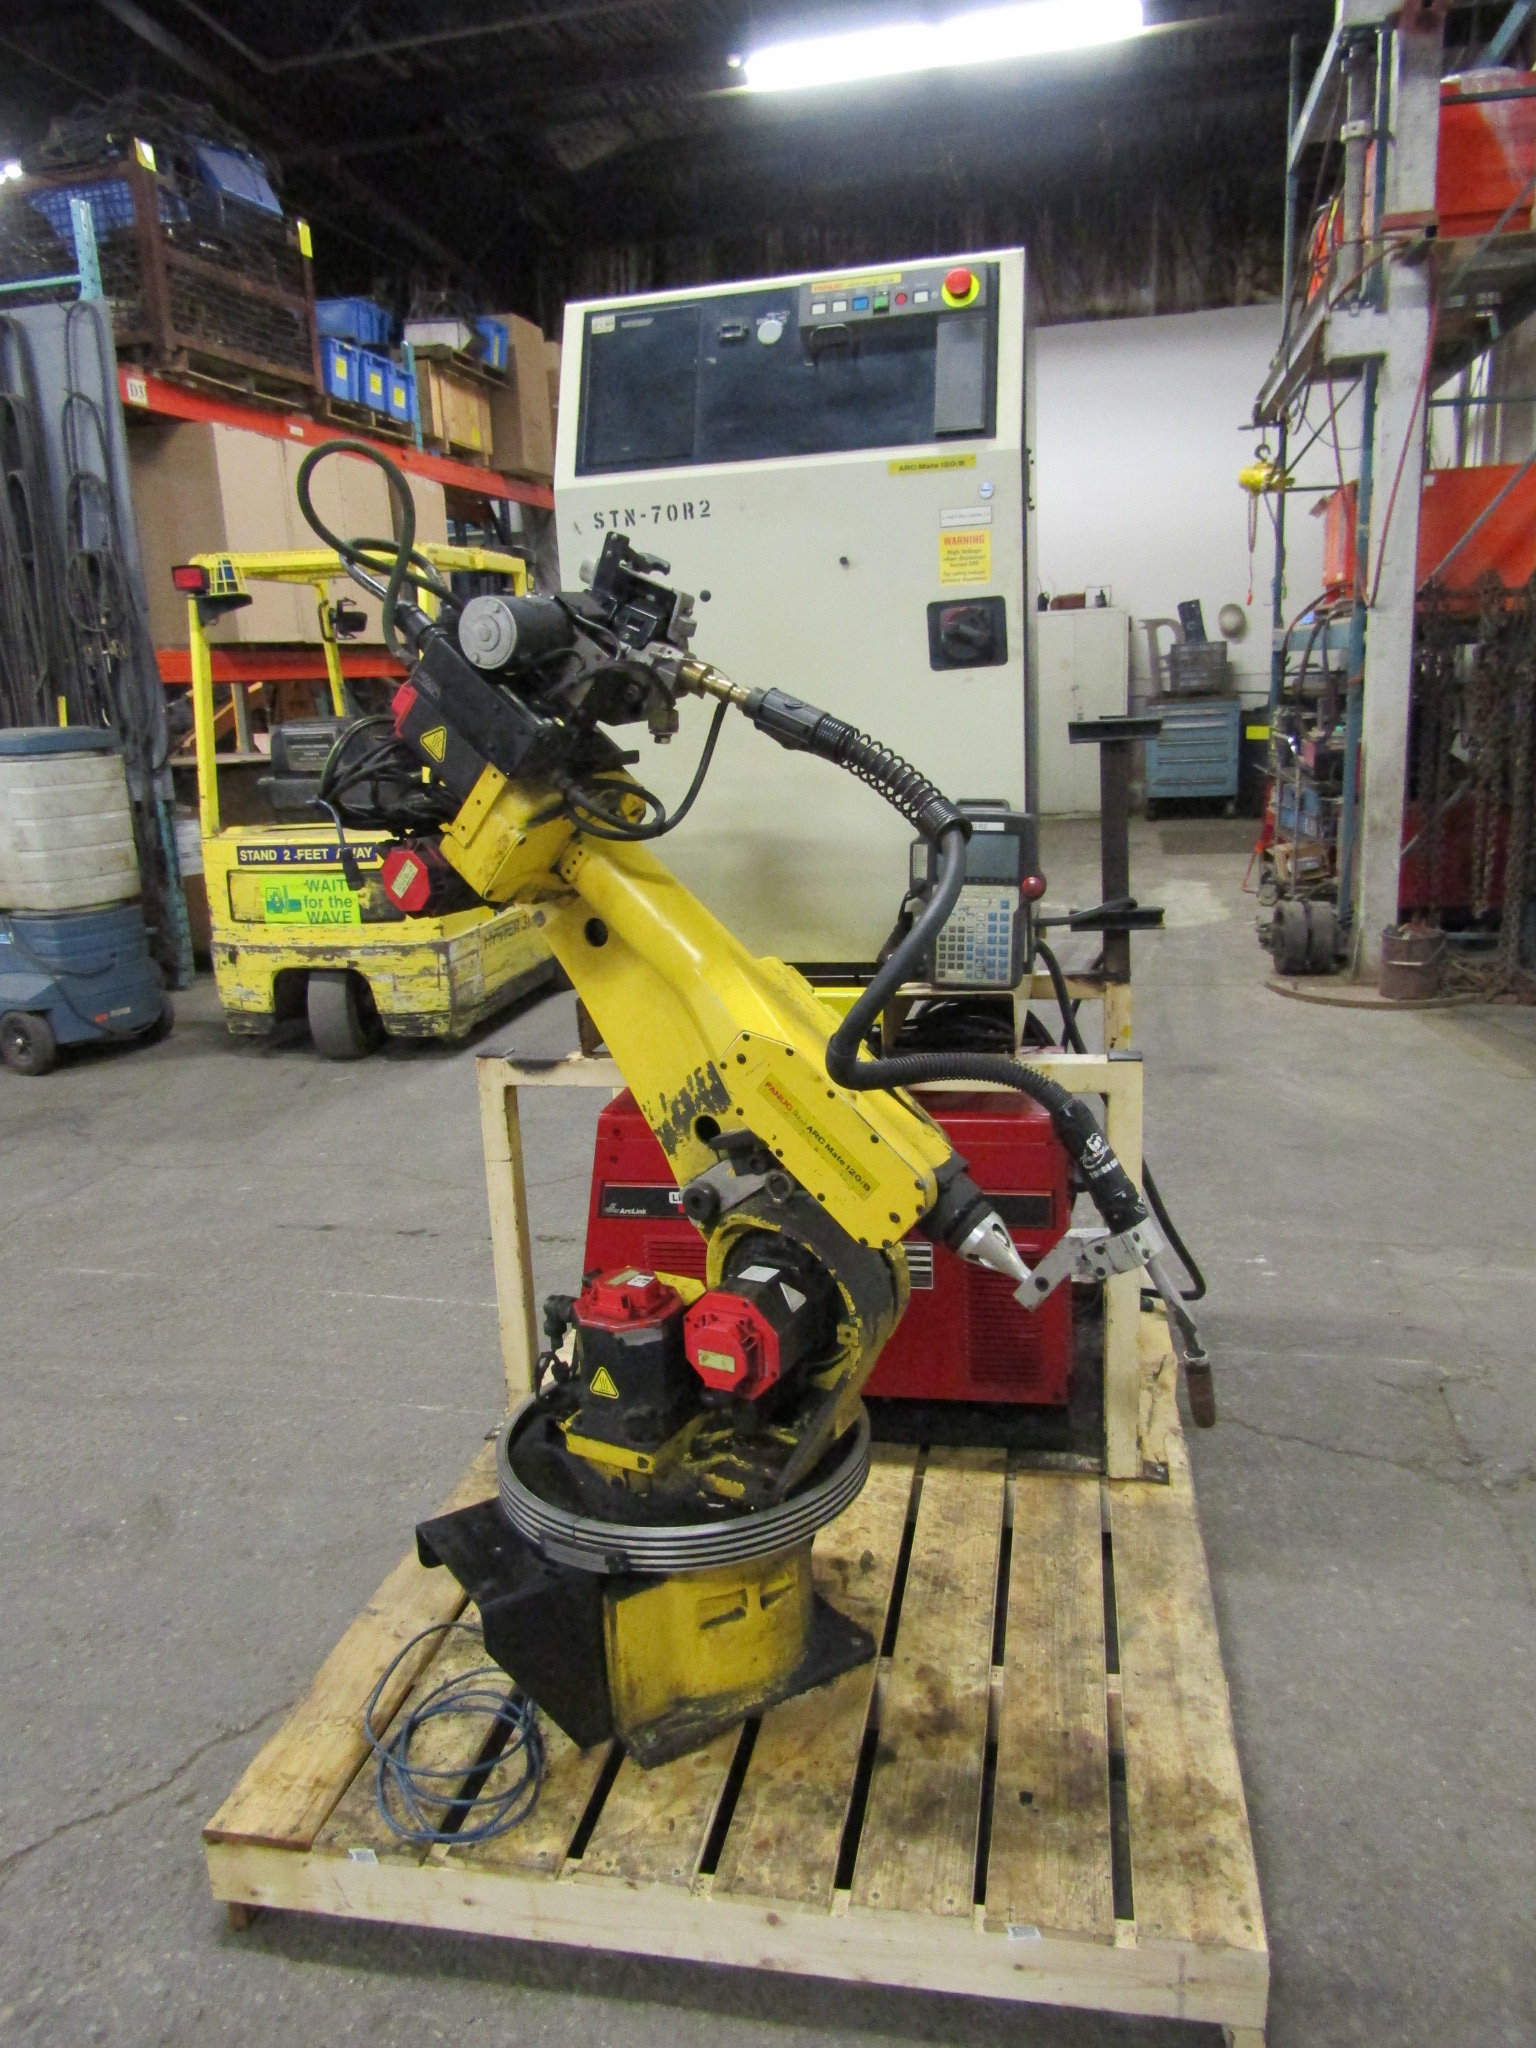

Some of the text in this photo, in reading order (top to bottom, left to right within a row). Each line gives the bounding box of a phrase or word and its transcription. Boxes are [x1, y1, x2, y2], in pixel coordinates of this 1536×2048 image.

[944, 534, 985, 546] WARNING
[239, 849, 278, 862] STAND
[283, 849, 291, 861] 2
[296, 848, 329, 861] FEET
[306, 878, 347, 893] WAIT
[303, 895, 353, 909] for the
[306, 911, 353, 924] WAVE
[765, 1081, 793, 1111] FANUC
[806, 1125, 826, 1145] ARC
[825, 1143, 846, 1166] Mate
[620, 1207, 648, 1215] ArcLink
